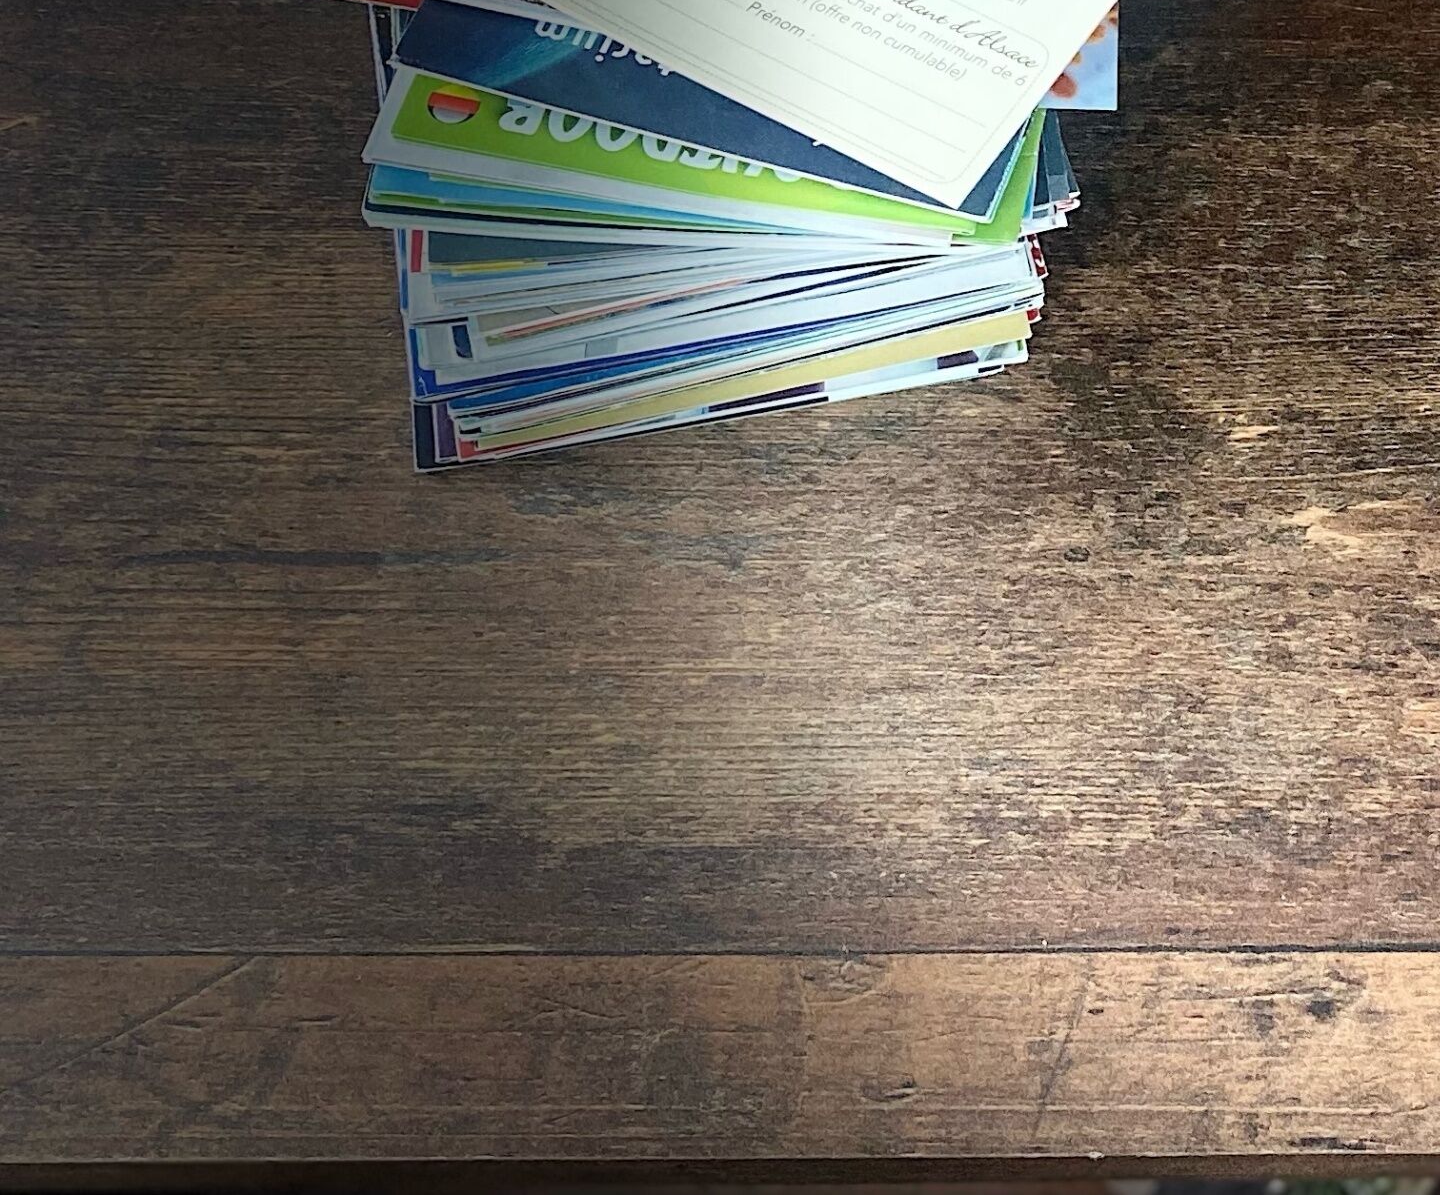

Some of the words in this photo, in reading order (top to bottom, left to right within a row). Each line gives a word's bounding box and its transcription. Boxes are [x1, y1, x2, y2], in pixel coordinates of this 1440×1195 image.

[744, 0, 806, 39] Prénom
[849, 18, 883, 40] non
[882, 33, 968, 83] cumulable)
[883, 7, 918, 35] d'un
[917, 28, 990, 70] minimum
[990, 61, 1014, 81] de
[1013, 72, 1027, 88] 6
